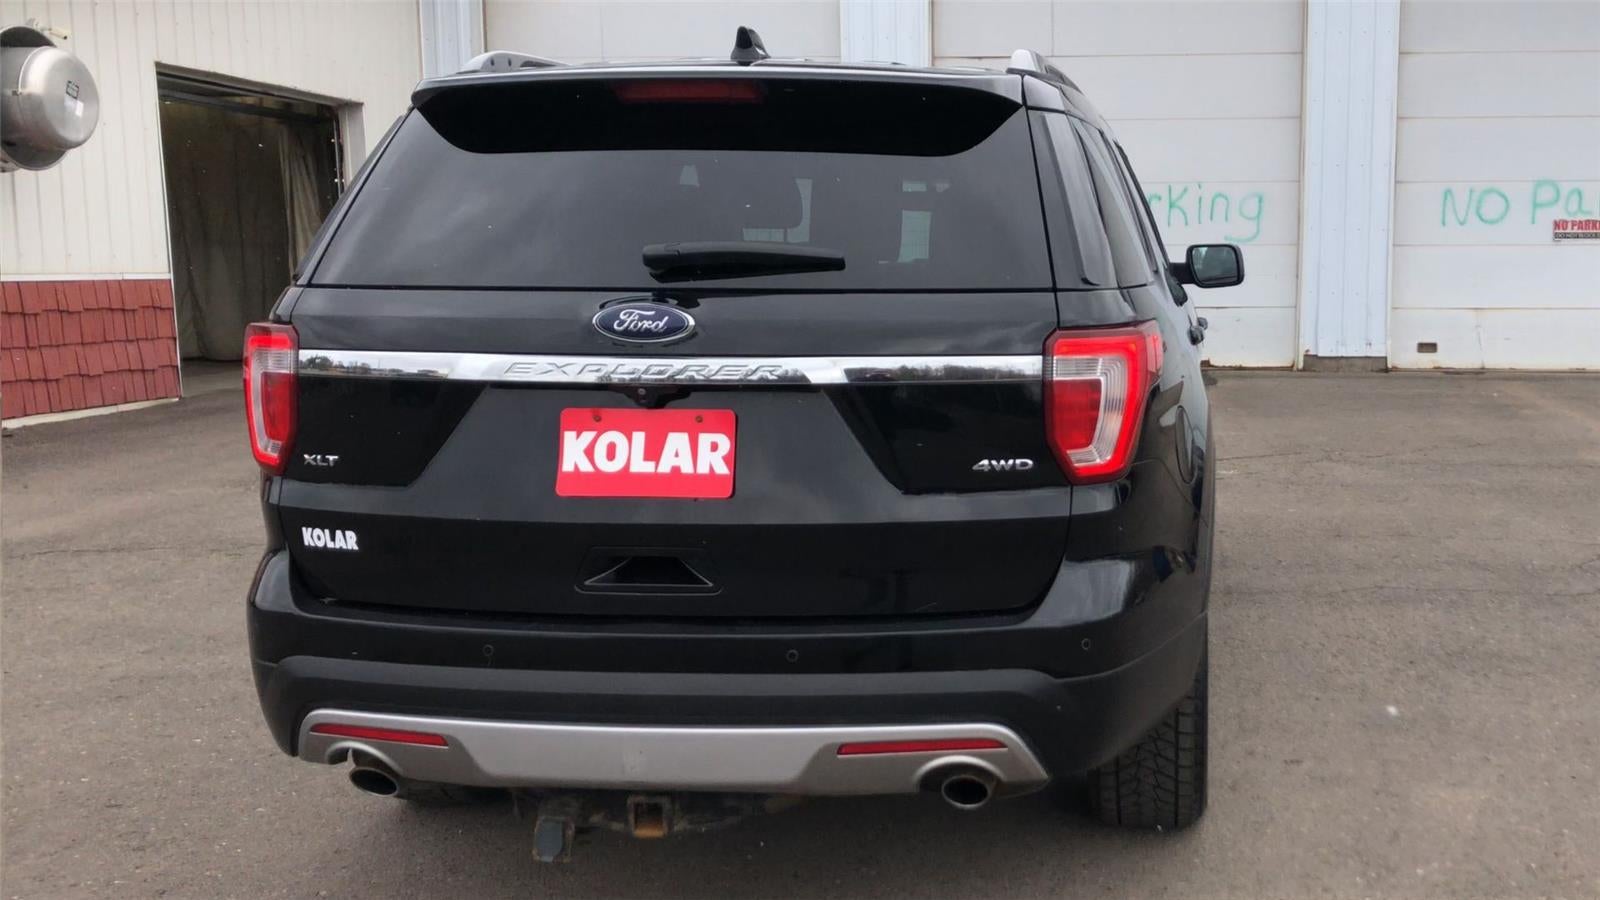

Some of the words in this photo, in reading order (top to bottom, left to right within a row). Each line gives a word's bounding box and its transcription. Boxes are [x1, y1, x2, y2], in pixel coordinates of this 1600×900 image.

[1530, 178, 1600, 225] Pa
[1553, 219, 1568, 230] NO
[613, 309, 669, 331] Ford
[504, 361, 784, 380] EXPLORER
[303, 454, 339, 467] XLT
[561, 430, 731, 475] KOLAR
[972, 459, 1034, 472] 4WD
[302, 526, 359, 550] KOLAR
